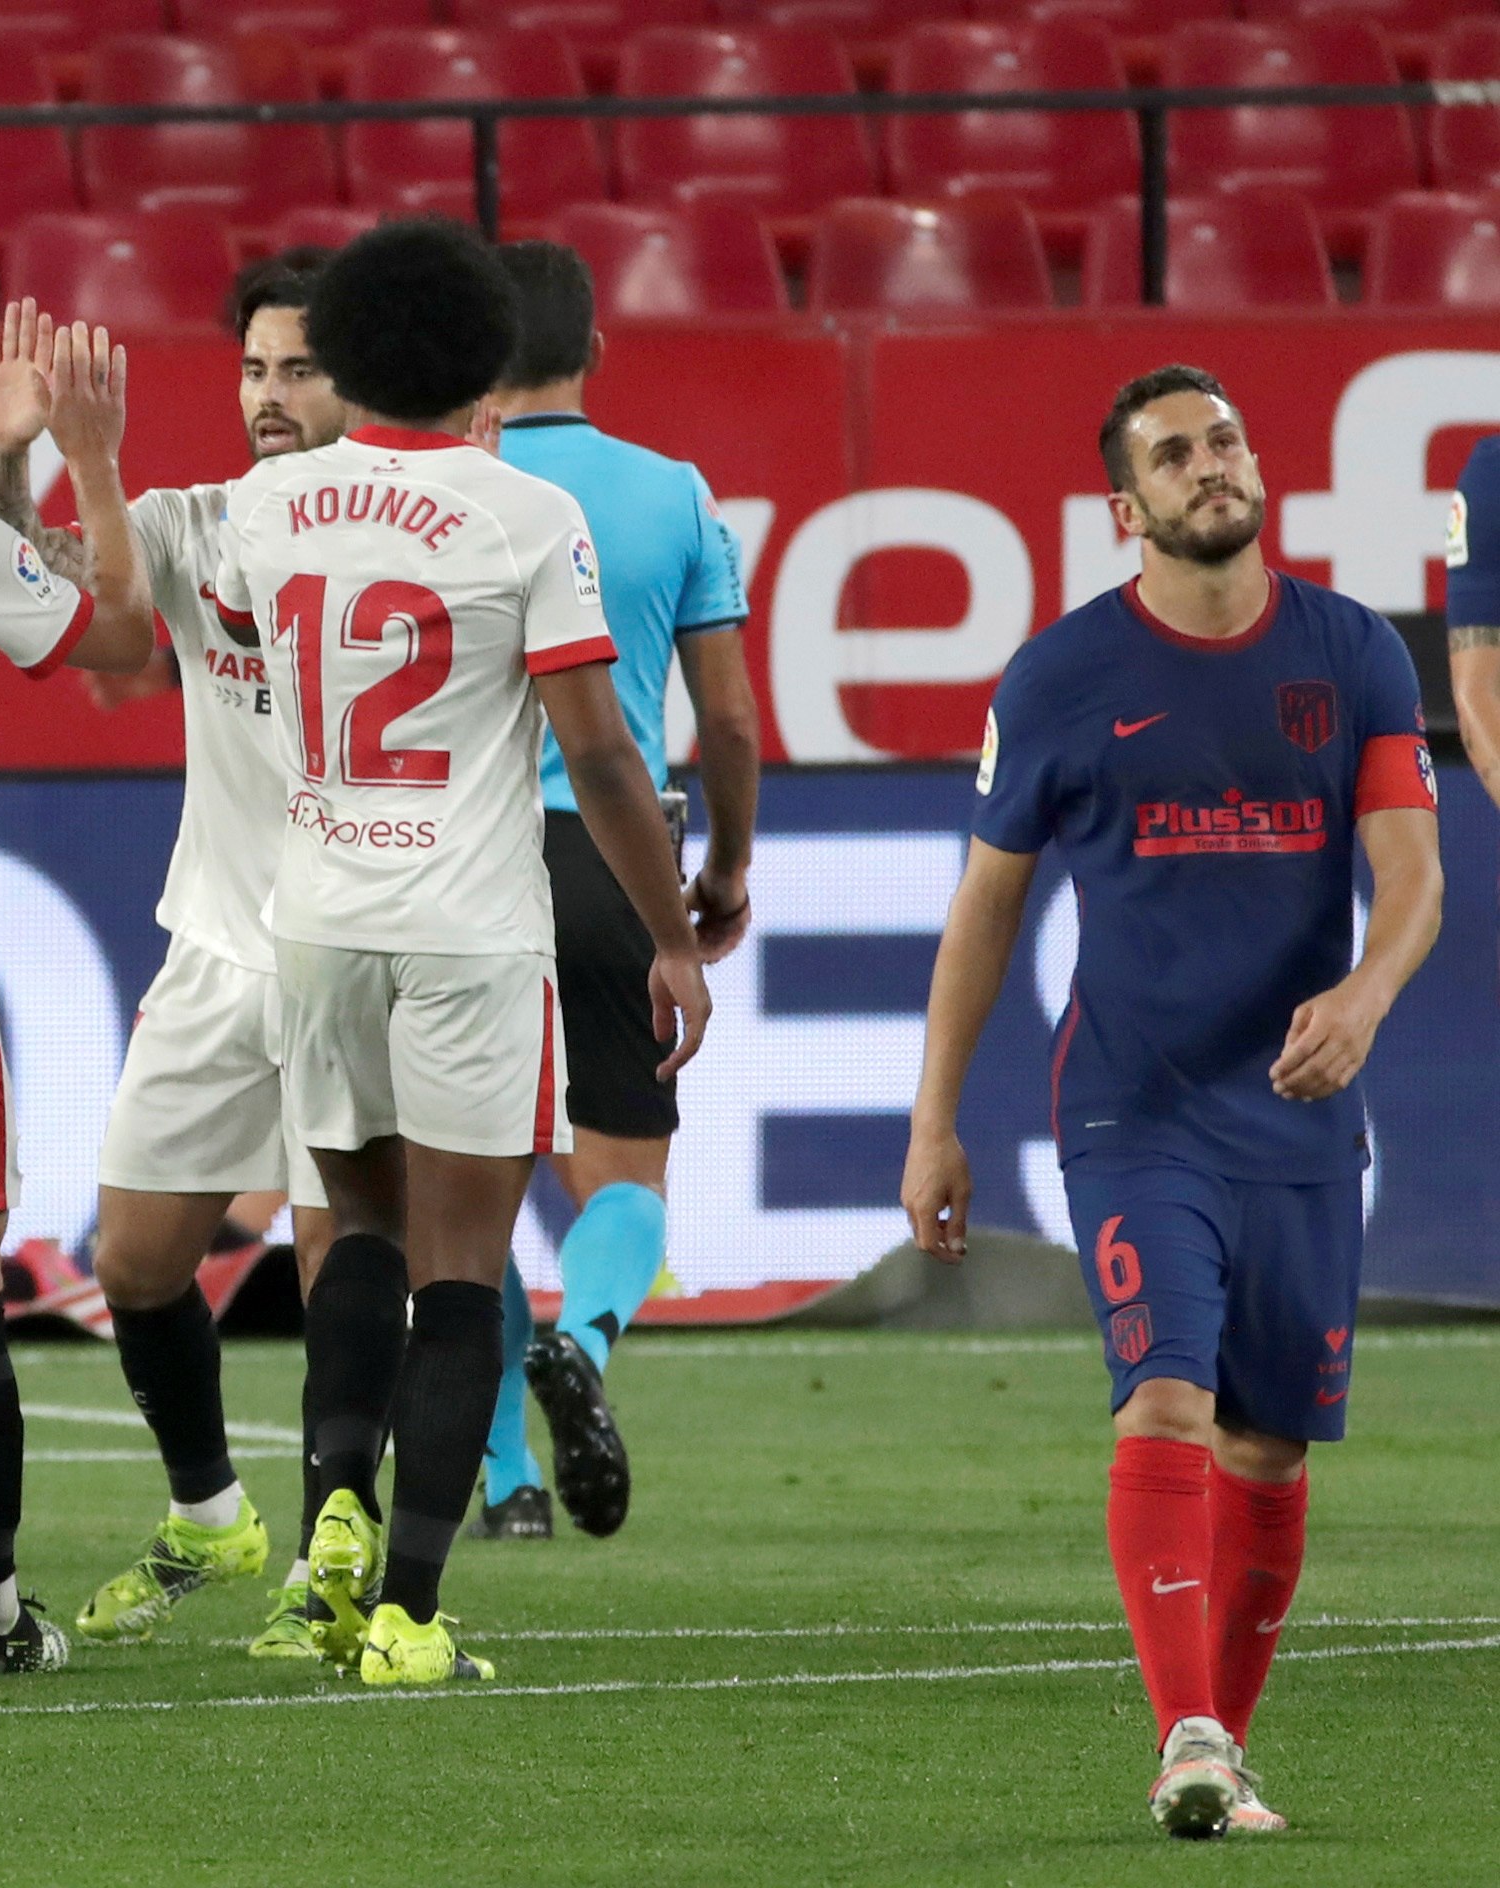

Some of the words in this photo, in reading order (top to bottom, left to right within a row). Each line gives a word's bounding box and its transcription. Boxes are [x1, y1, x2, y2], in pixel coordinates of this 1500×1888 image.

[286, 484, 469, 552] KOUNDÉ
[269, 572, 454, 789] 12
[287, 790, 437, 849] Axpress
[1136, 798, 1324, 836] Plus500
[1095, 1214, 1144, 1304] 6
